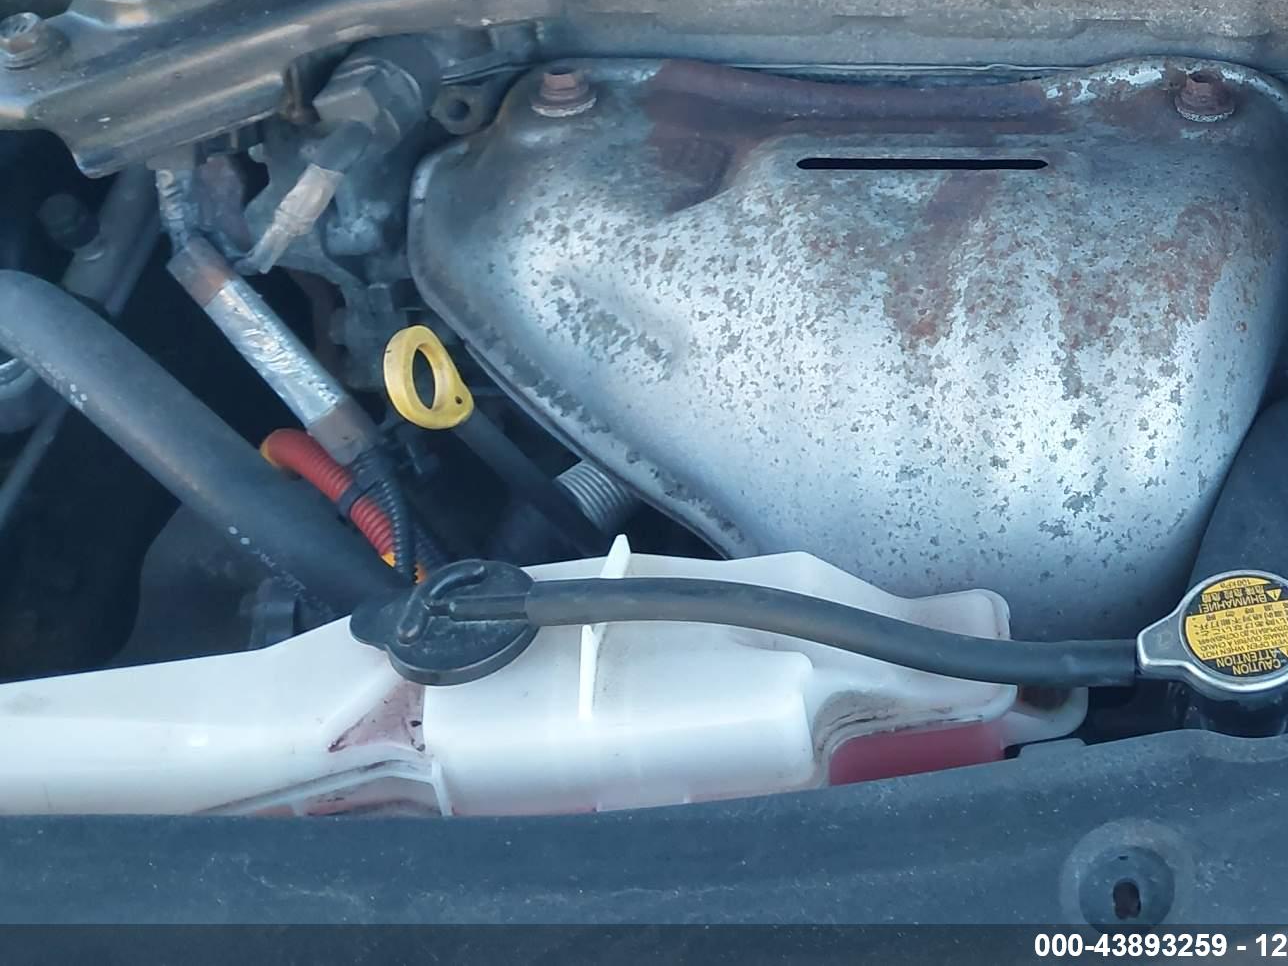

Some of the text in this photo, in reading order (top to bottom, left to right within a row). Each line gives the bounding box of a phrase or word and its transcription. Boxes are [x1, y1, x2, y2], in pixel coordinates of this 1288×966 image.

[1198, 593, 1267, 613] ВНИМАНИЕ!
[1215, 648, 1277, 667] ATTENTION
[1232, 657, 1281, 675] CAUTION
